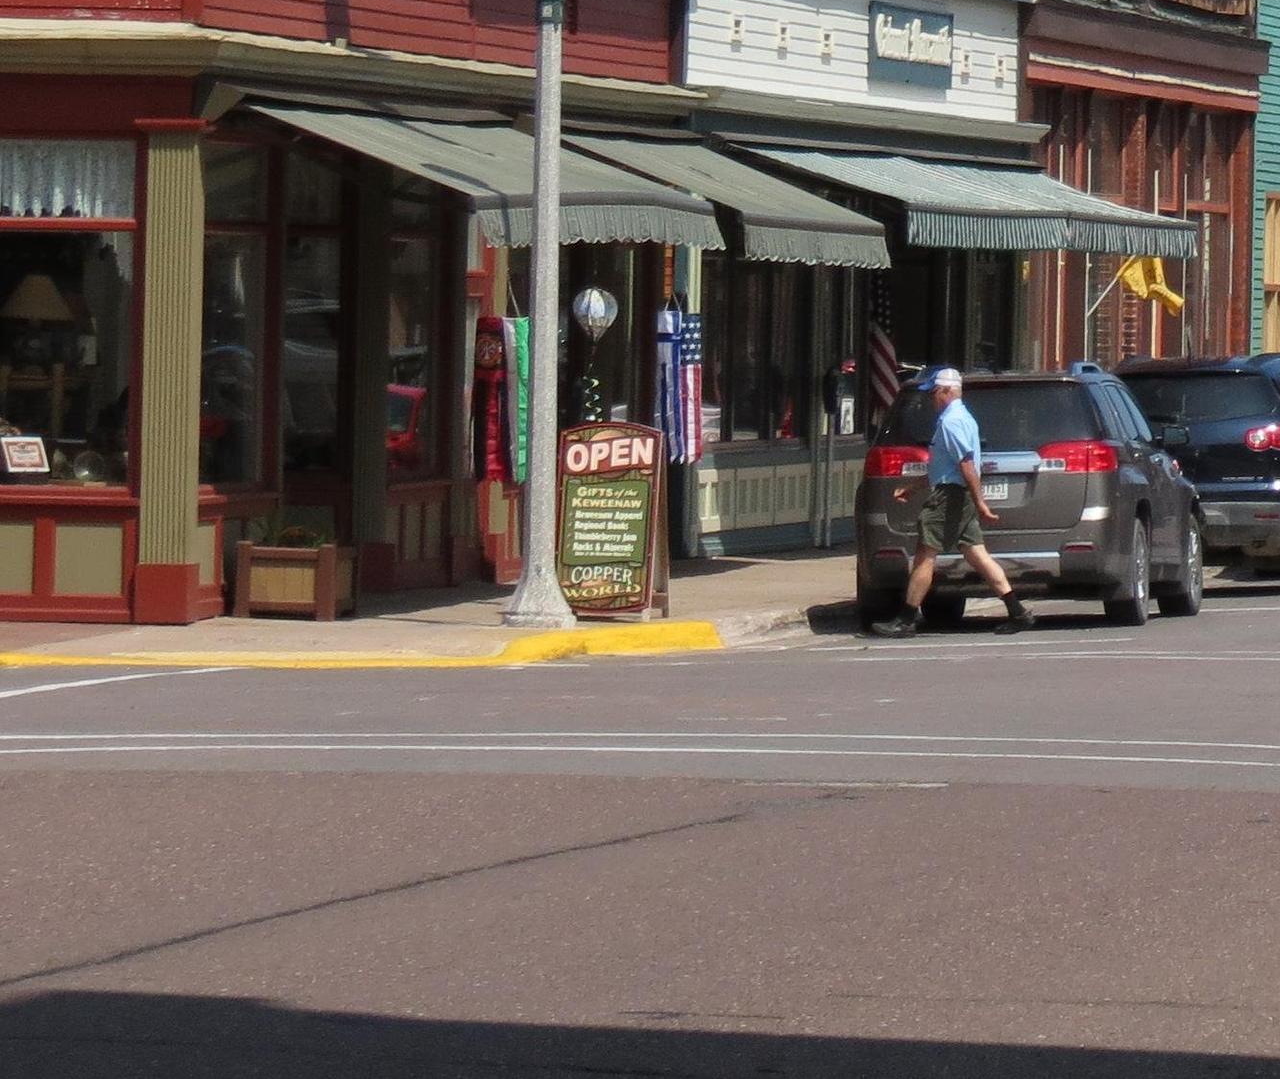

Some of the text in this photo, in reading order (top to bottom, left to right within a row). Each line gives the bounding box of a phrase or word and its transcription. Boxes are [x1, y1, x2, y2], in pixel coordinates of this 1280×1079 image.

[566, 437, 655, 472] OPEN
[614, 488, 624, 498] of
[625, 487, 638, 497] the
[572, 497, 642, 509] KEWEENAW
[571, 565, 633, 586] COPPER
[563, 584, 642, 599] WORLD
